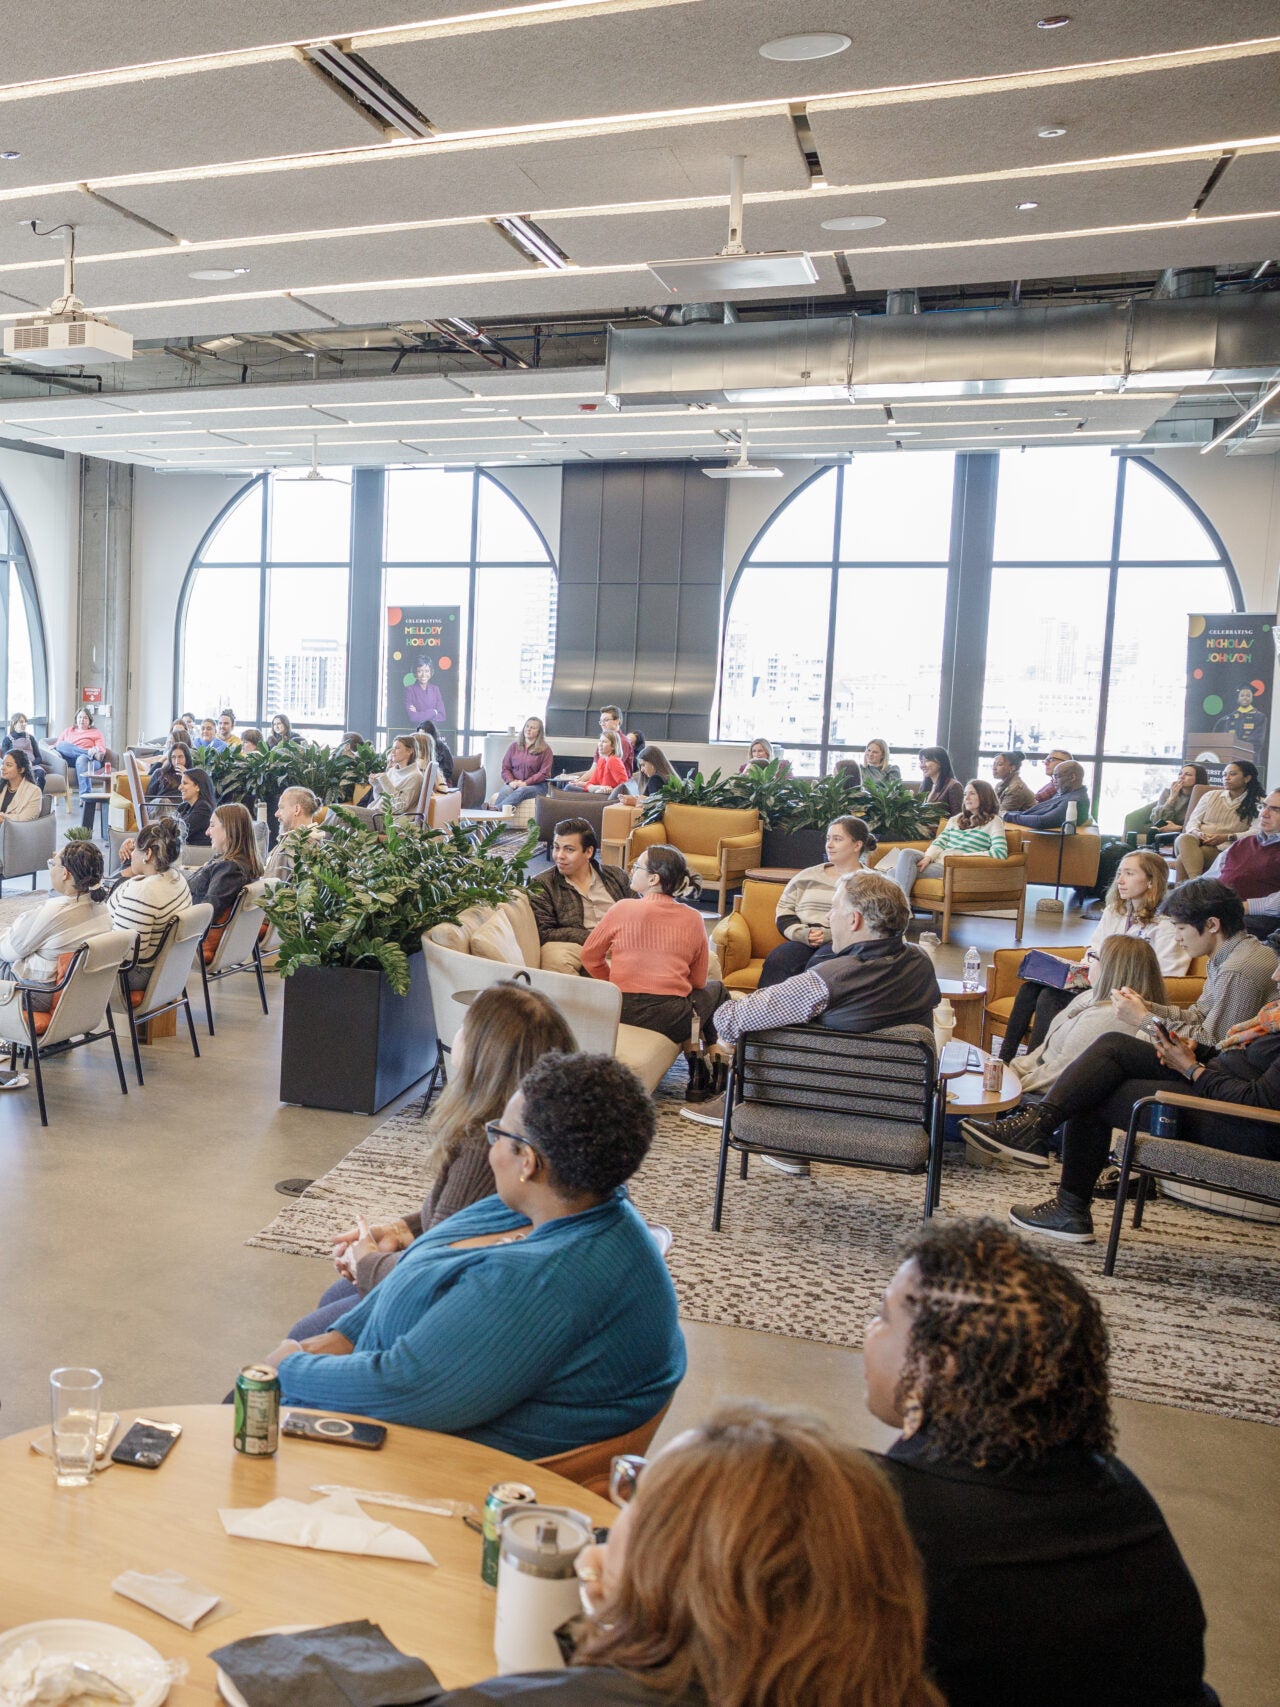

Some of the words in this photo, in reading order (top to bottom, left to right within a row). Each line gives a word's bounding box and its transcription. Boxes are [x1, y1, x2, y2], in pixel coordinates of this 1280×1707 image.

[404, 626, 442, 635] MELLODY
[405, 637, 441, 646] HOBSON
[1206, 638, 1255, 649] NICHOLAS
[1206, 652, 1252, 663] JOHNSON
